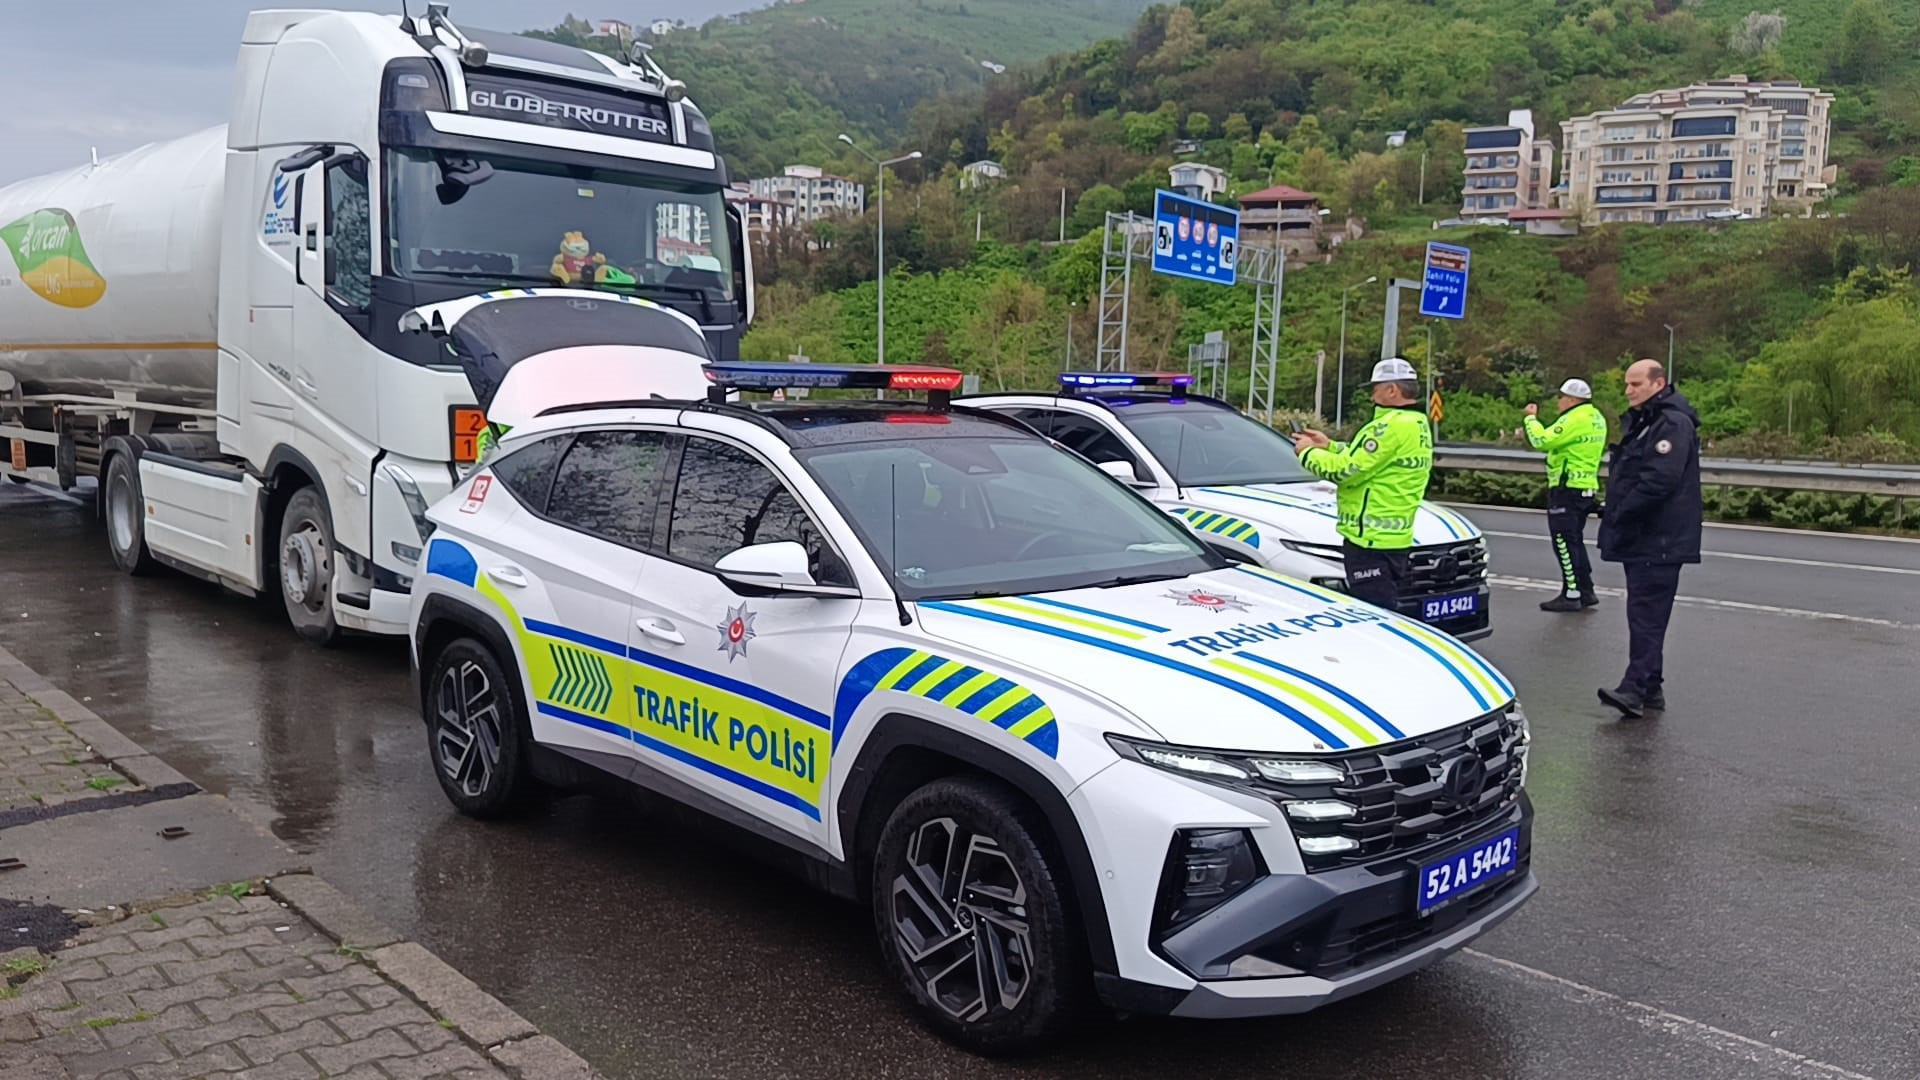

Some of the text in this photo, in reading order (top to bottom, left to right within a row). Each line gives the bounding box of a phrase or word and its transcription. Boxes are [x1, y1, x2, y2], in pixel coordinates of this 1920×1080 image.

[470, 90, 667, 136] GLOBETROTTER
[1426, 596, 1473, 618] 52 A 5421
[1168, 622, 1303, 657] TRAFİK
[633, 685, 815, 784] TRAFİK POLİSİ
[1426, 864, 1451, 899] 52
[1454, 857, 1467, 888] A
[1471, 837, 1512, 880] 5442
